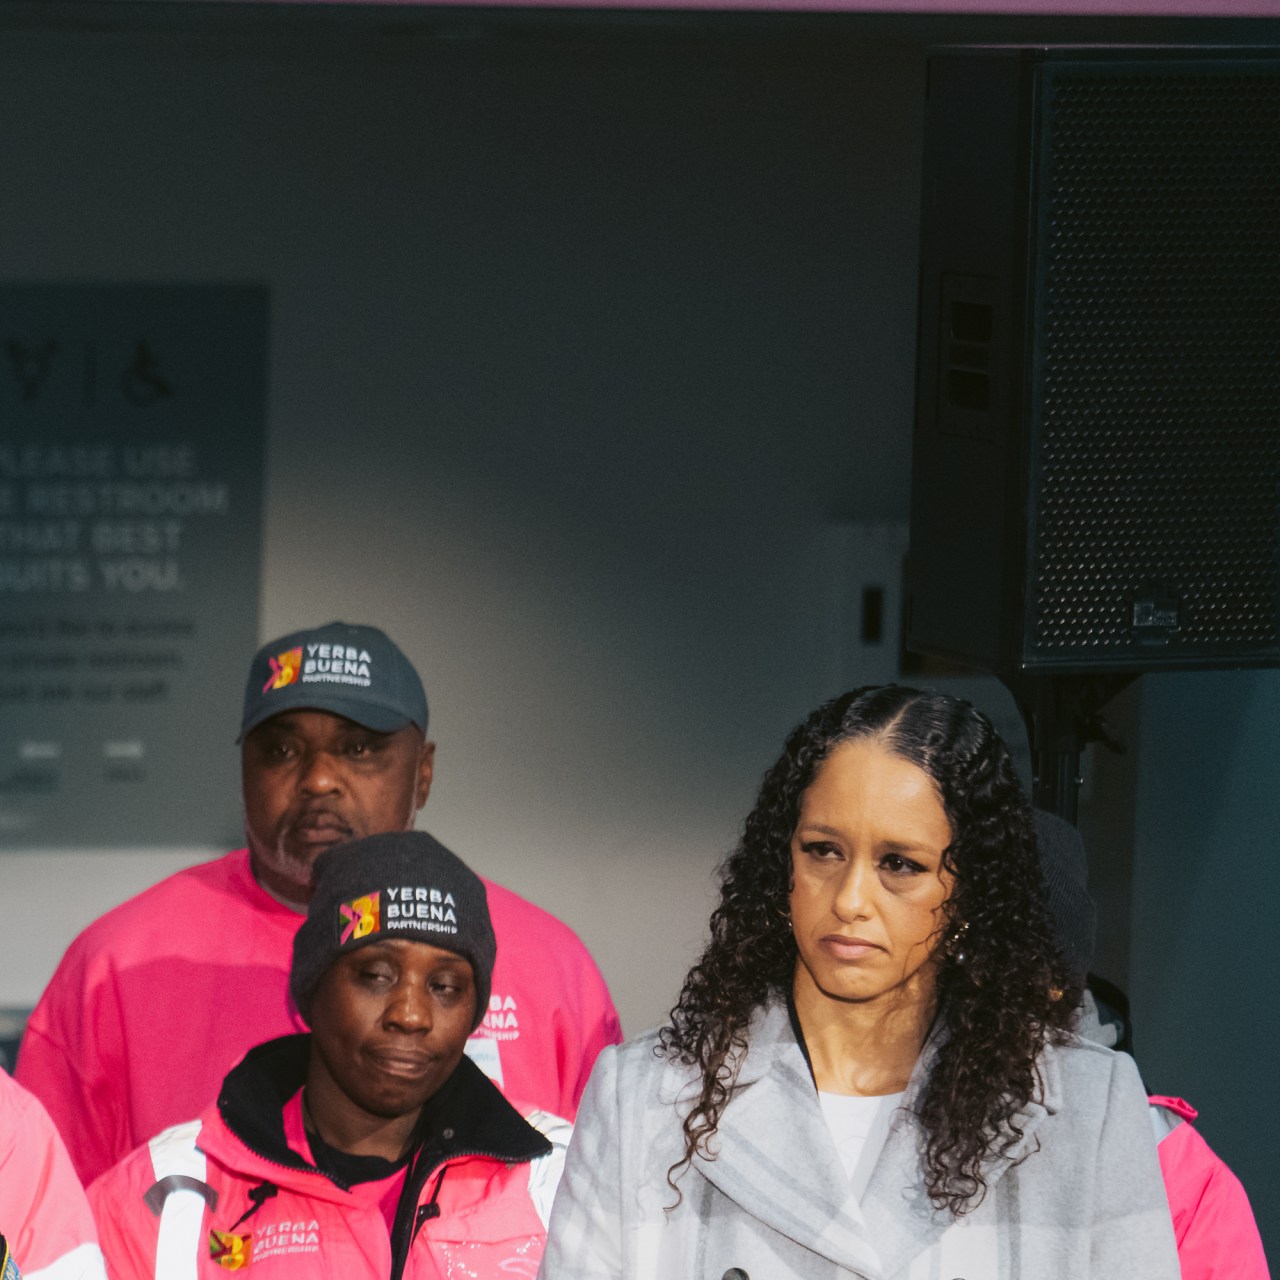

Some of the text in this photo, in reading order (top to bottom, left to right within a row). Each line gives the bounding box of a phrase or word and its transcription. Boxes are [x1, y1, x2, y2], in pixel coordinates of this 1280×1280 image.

[307, 643, 371, 664] YERBA
[304, 659, 370, 679] BUENA
[302, 673, 371, 687] PARTNERSHIP
[387, 887, 455, 908] YERBA
[387, 903, 457, 924] BUENA
[387, 920, 458, 935] PARTNERSHIP
[256, 1219, 320, 1239] YERBA
[253, 1232, 320, 1255] BUENA
